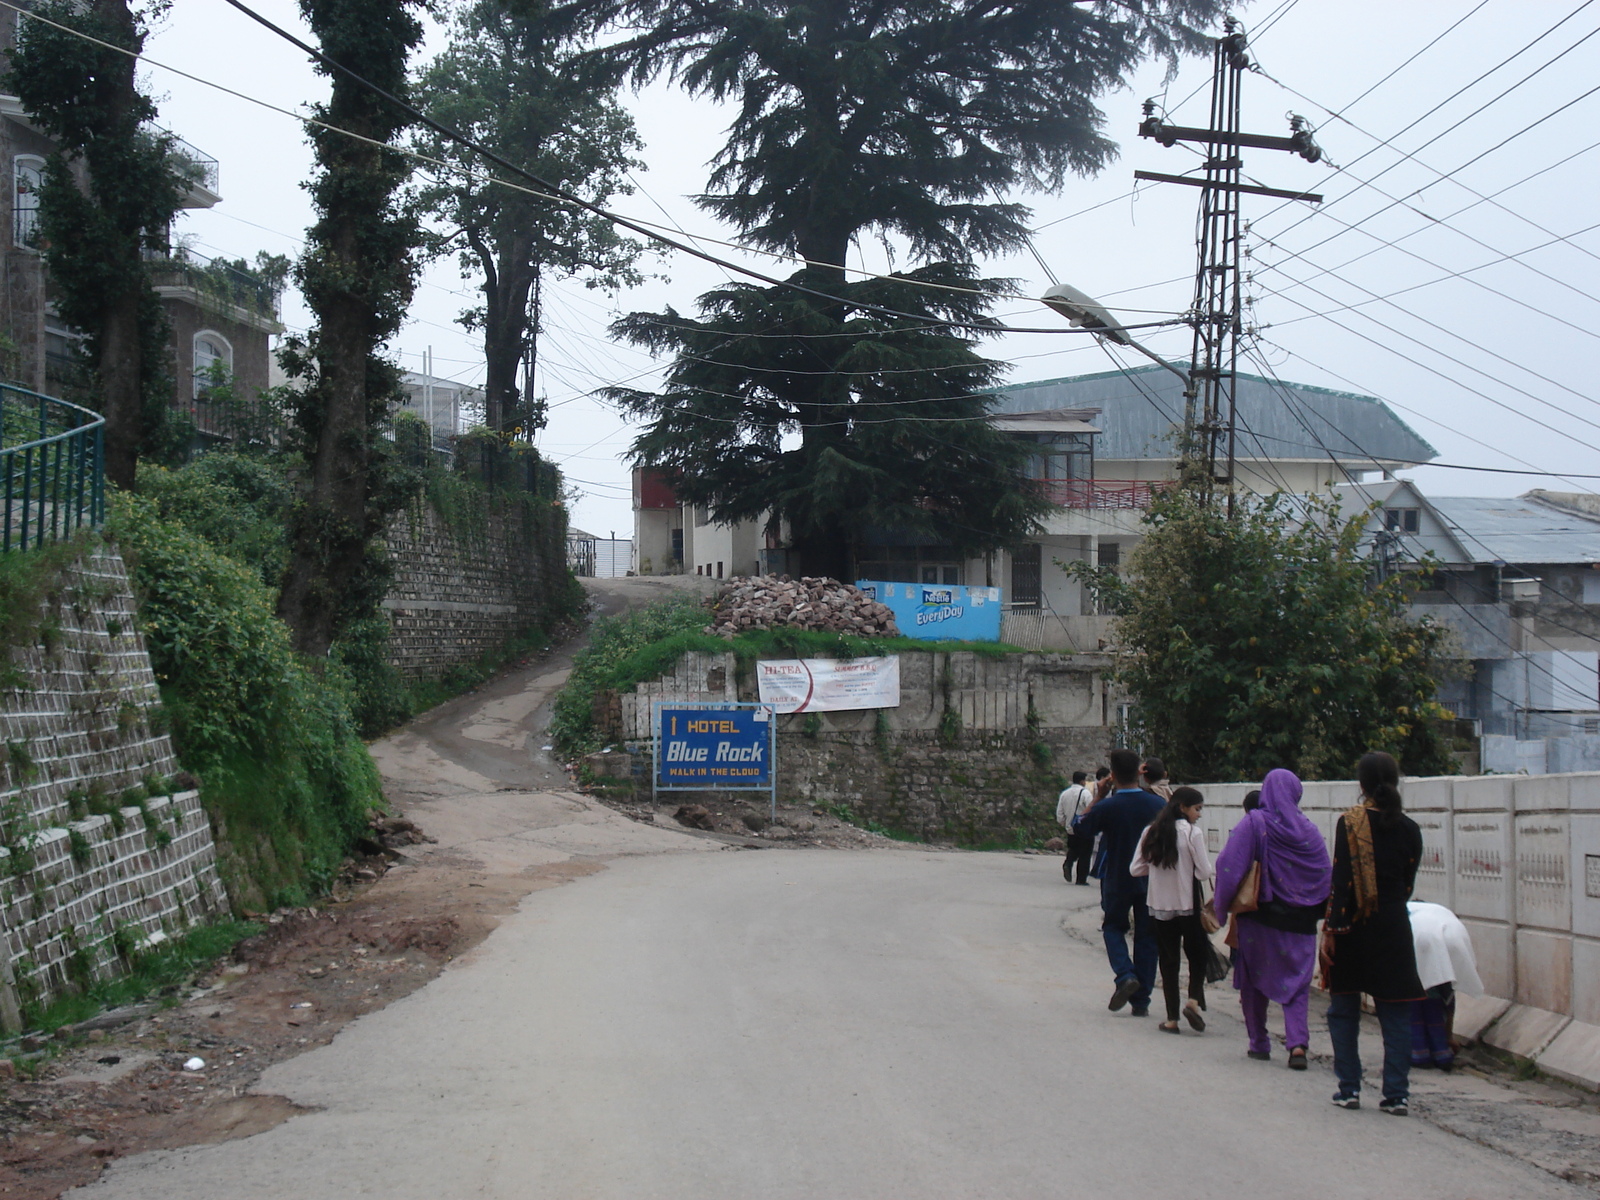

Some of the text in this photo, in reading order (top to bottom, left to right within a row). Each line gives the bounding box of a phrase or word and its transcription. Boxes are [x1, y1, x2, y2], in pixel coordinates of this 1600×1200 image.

[916, 606, 964, 625] EveryDay
[687, 720, 740, 733] HOTEL
[666, 741, 764, 762] Blue Rock
[669, 768, 760, 776] WALK IN THE CLOUD
